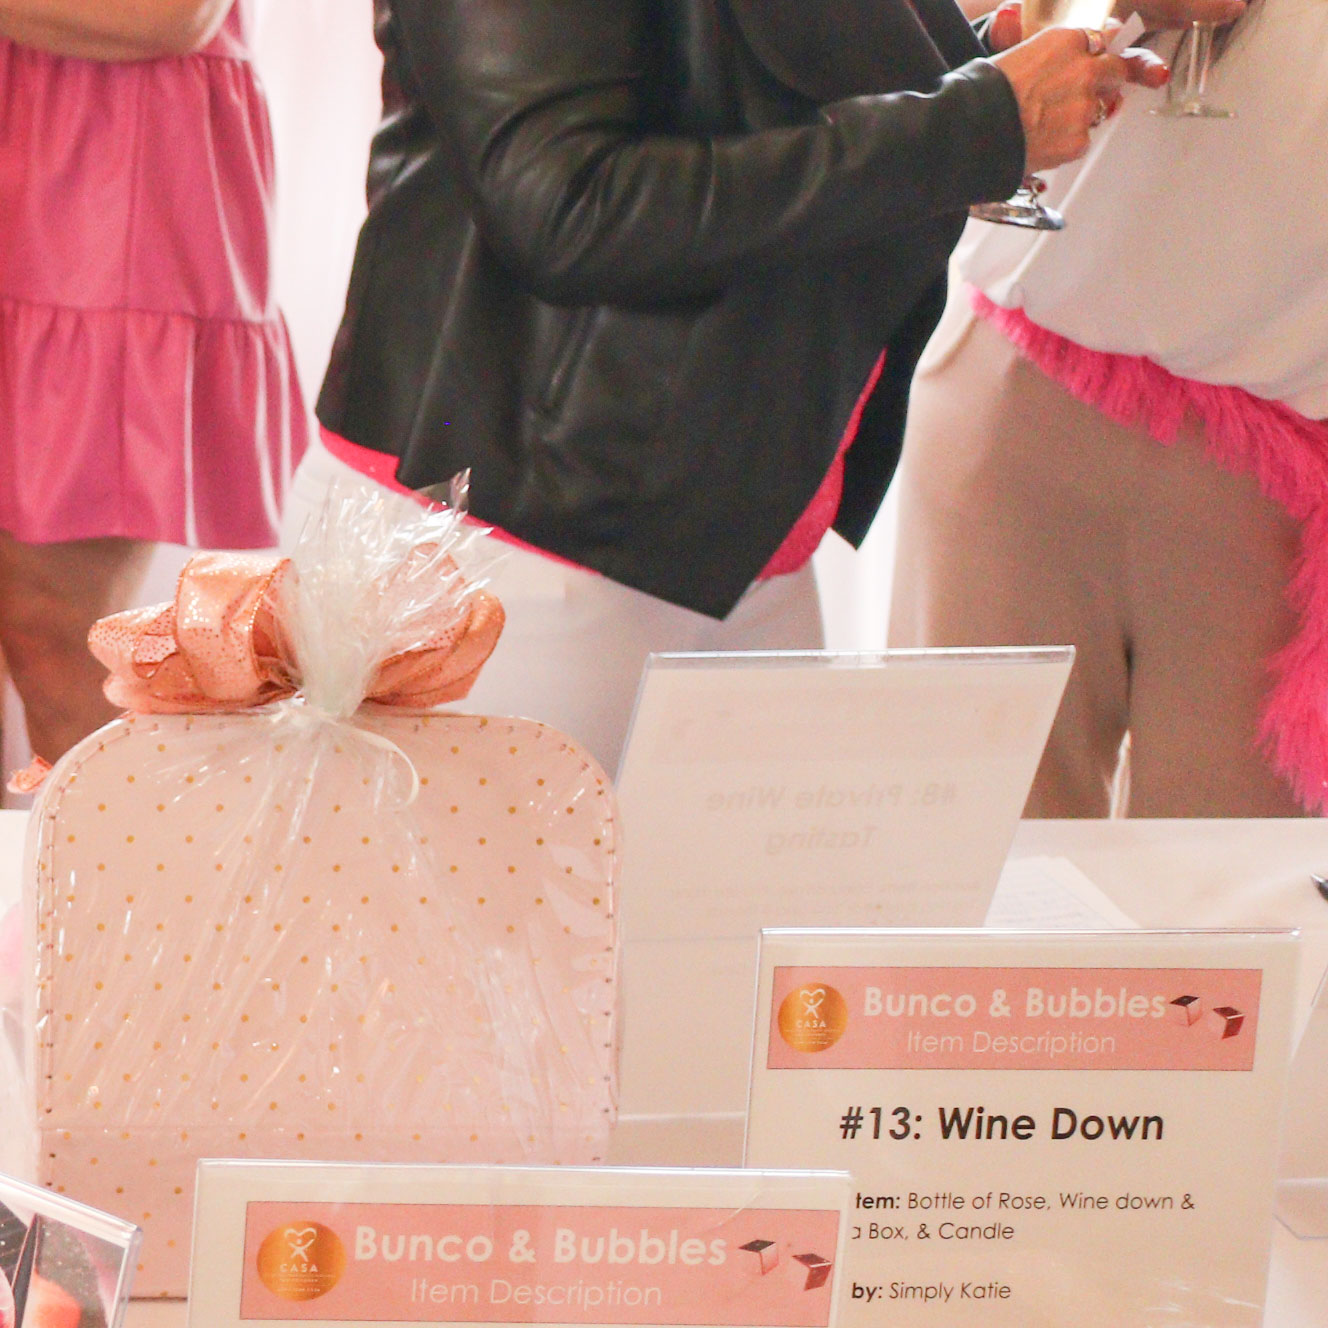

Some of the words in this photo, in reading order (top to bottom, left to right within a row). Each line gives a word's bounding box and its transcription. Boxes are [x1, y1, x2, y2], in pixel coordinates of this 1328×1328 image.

[838, 1105, 922, 1140] #13:
[937, 1105, 1036, 1140] Wine
[1050, 1107, 1163, 1140] Down
[855, 1191, 900, 1209] tem:
[907, 1191, 965, 1209] Bottle
[971, 1191, 992, 1210] of
[998, 1191, 1050, 1210] Rose,
[1058, 1191, 1109, 1210] Wine
[1114, 1192, 1173, 1210] down
[1179, 1192, 1195, 1210] &
[868, 1221, 908, 1240] Box,
[916, 1222, 931, 1240] &
[937, 1221, 1015, 1240] Candle
[851, 1281, 883, 1303] by:
[888, 1281, 954, 1303] Simply
[959, 1281, 1011, 1299] Katie
